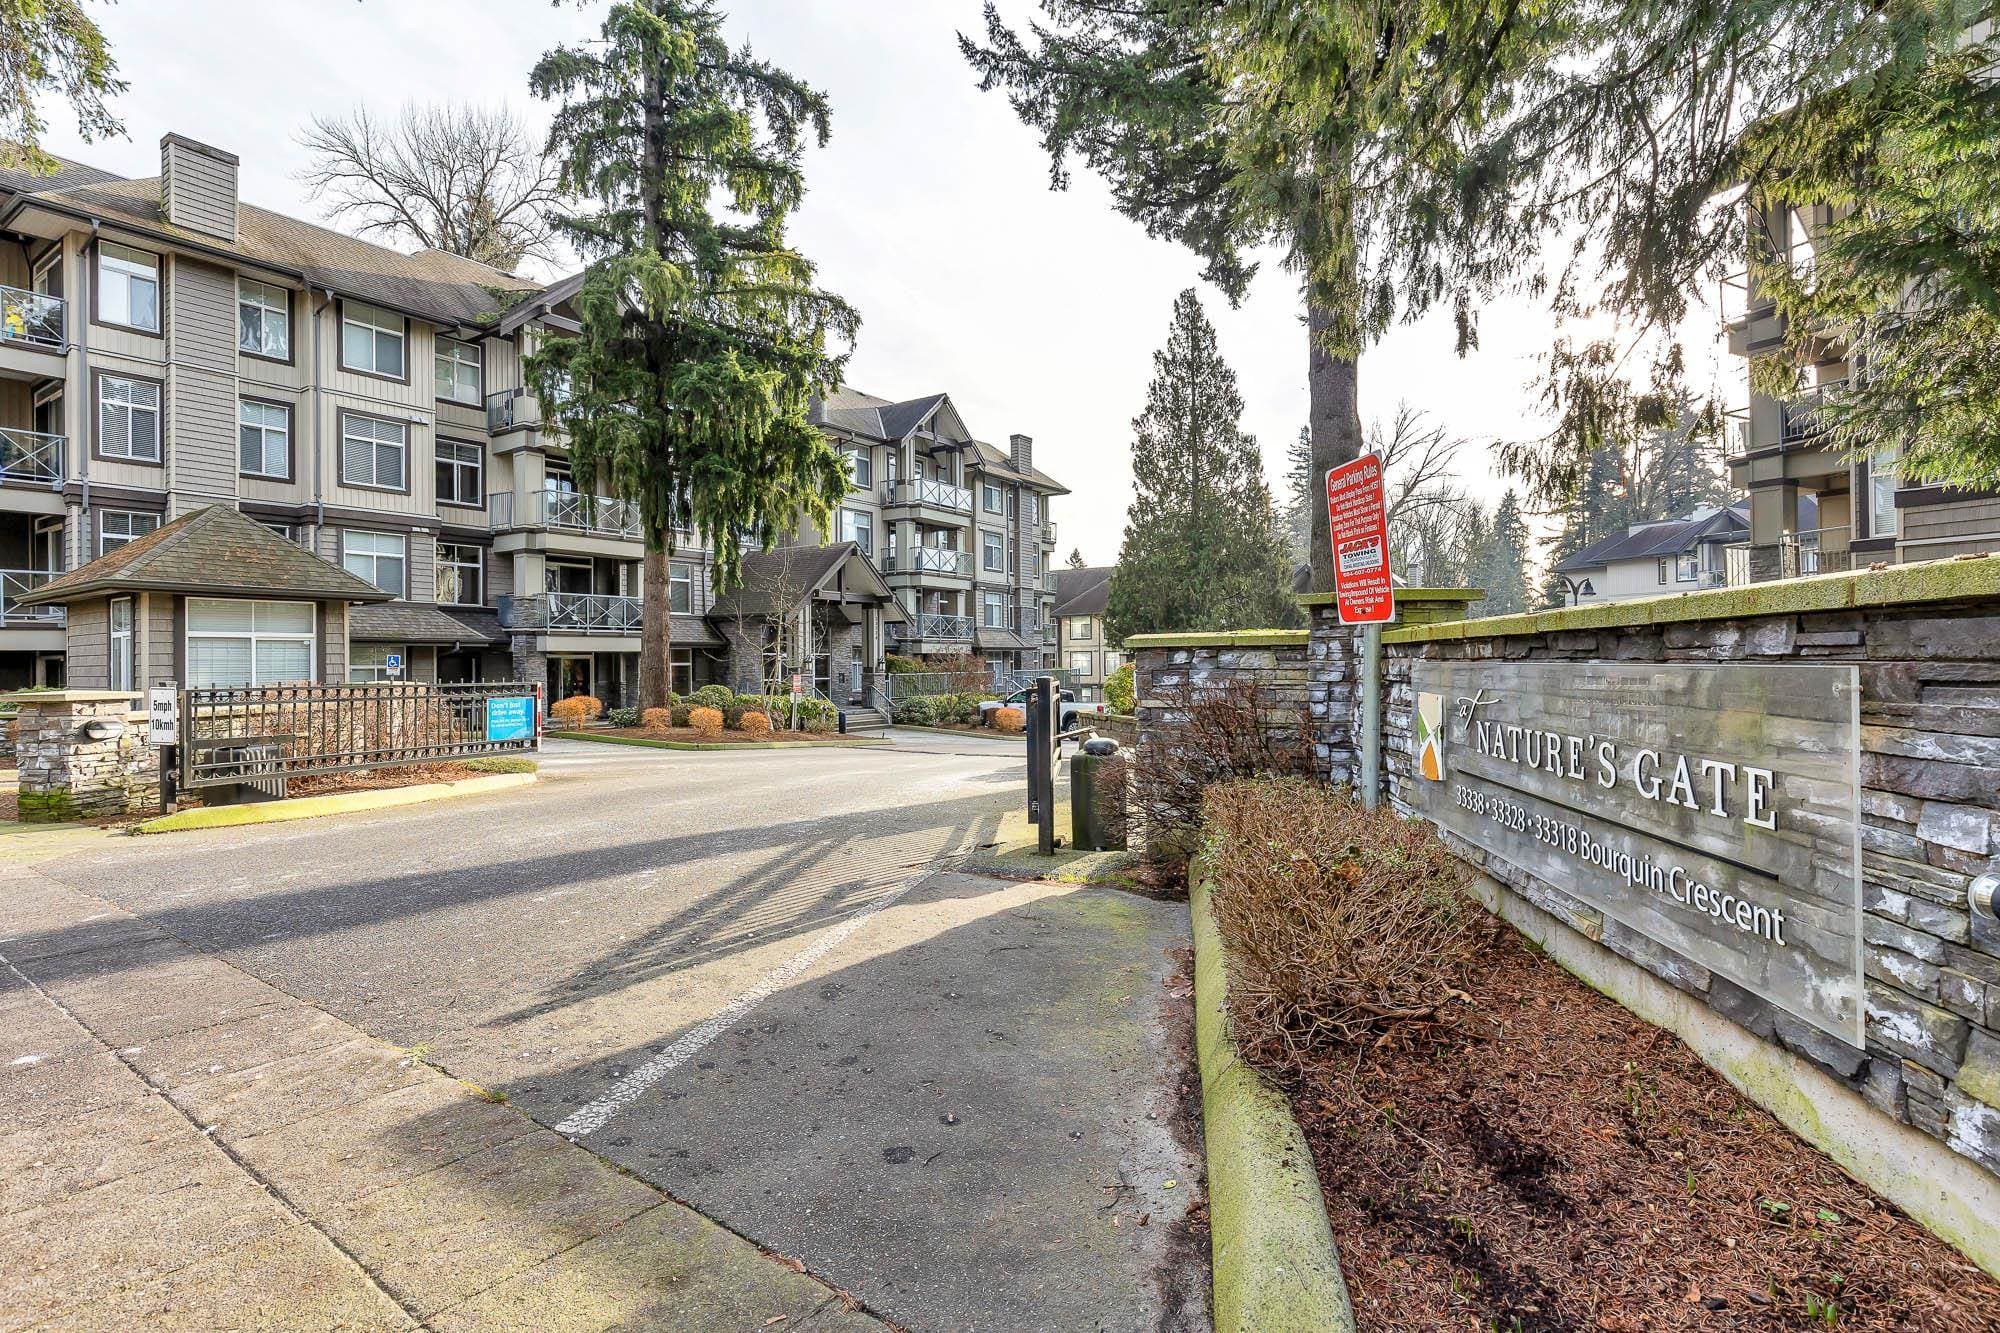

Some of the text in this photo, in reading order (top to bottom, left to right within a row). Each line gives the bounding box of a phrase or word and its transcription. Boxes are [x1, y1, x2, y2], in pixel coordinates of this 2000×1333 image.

[1331, 464, 1377, 491] General Parking Rules
[1343, 548, 1376, 559] TOWING
[1341, 581, 1358, 589] Violations
[153, 700, 172, 714] 5mph
[151, 719, 174, 730] 10kmh
[1476, 720, 1778, 831] NATURE'S GATE
[1456, 785, 1787, 946] 33338 33328 33318 Bourquin Crescent
